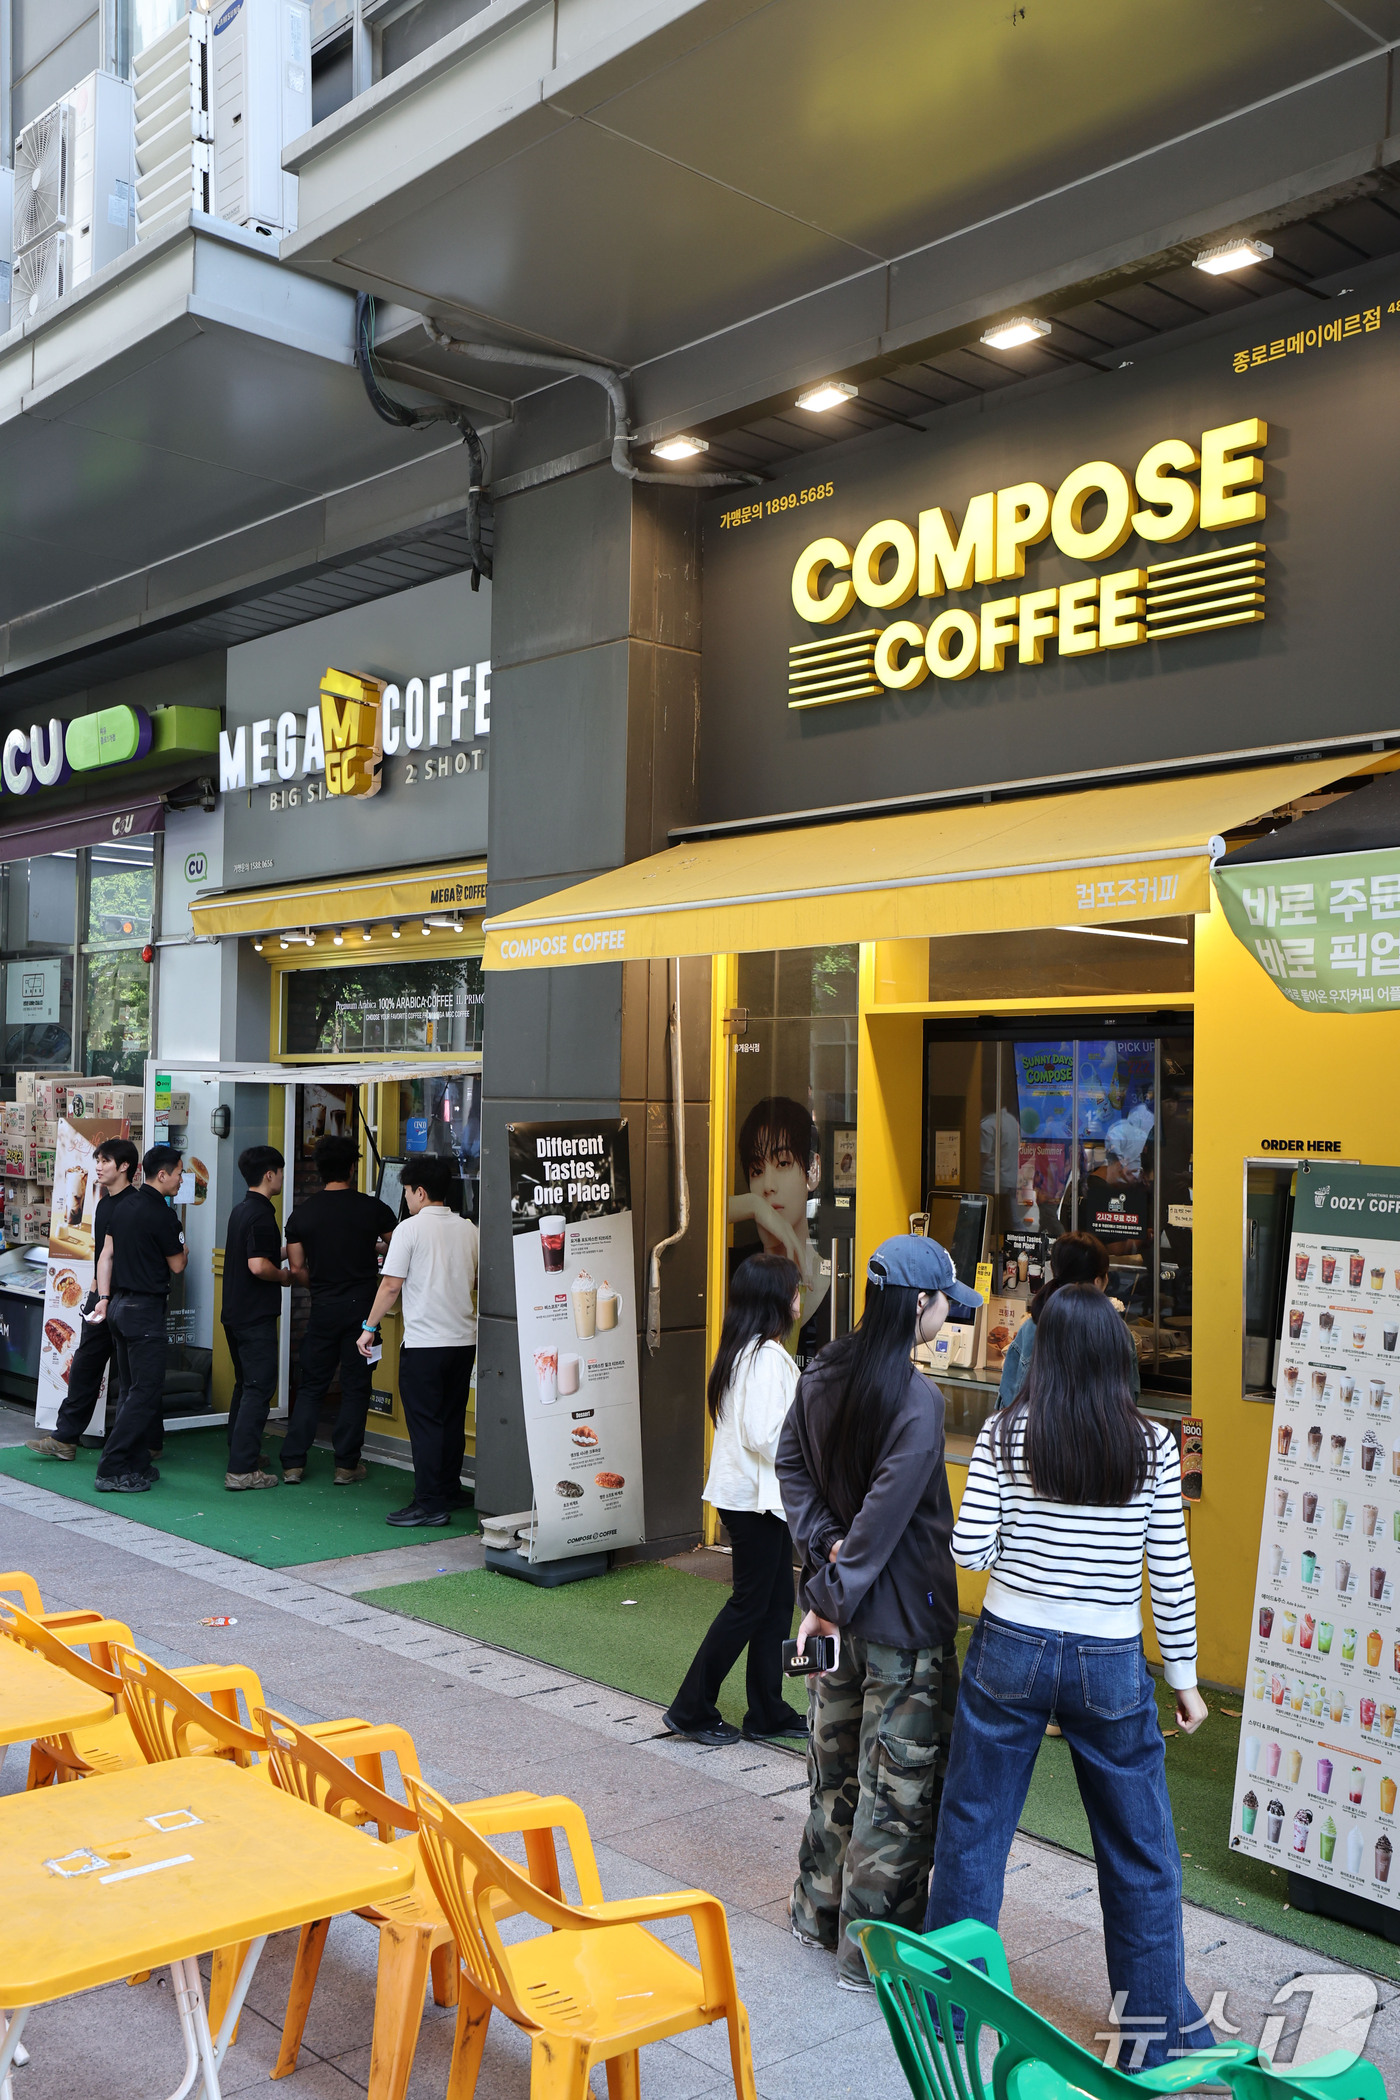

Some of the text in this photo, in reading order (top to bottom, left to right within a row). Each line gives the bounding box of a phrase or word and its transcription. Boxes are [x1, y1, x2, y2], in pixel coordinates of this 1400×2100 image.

[216, 4, 241, 29] SAMSUNG
[1232, 305, 1381, 374] 종로르메이에르점
[720, 481, 834, 529] 가맹문의 1899.5685
[791, 417, 1267, 625] COMPOSE
[874, 568, 1147, 691] COFFEE
[3, 718, 64, 795] CU
[219, 705, 326, 793] MEGA
[269, 749, 486, 812] BIG 2 SHOT
[188, 860, 203, 876] CU
[431, 884, 488, 904] MEGA COFFE
[1076, 874, 1179, 909] 컴포즈커피
[1242, 874, 1400, 927] 바로 주문
[500, 930, 626, 959] COMPOSE COFFEE
[1255, 931, 1400, 979] 바로 픽업
[379, 997, 395, 1010] 100%
[396, 996, 426, 1009] ARABICA
[427, 994, 453, 1007] COFFEE
[1300, 989, 1328, 1003] 돌아온
[1329, 986, 1374, 1004] 우지커피
[734, 1042, 760, 1053] 휴게음식점
[1118, 1041, 1155, 1052] PICK UP
[1022, 1055, 1051, 1069] SUNNY
[1052, 1053, 1073, 1066] DAYS
[1026, 1067, 1073, 1084] COMPOSE
[536, 1135, 604, 1158] Different
[1037, 1146, 1062, 1156] Summer
[1261, 1139, 1341, 1152] ORDER HERE
[543, 1161, 599, 1181] Tastes,
[533, 1183, 610, 1205] One Place
[1330, 1196, 1365, 1211] OOZY
[1096, 1213, 1138, 1223] 2시간 무료 주차
[1007, 1234, 1026, 1242] Different
[567, 1534, 592, 1544] COMPOSE
[598, 1528, 618, 1538] COFFEE
